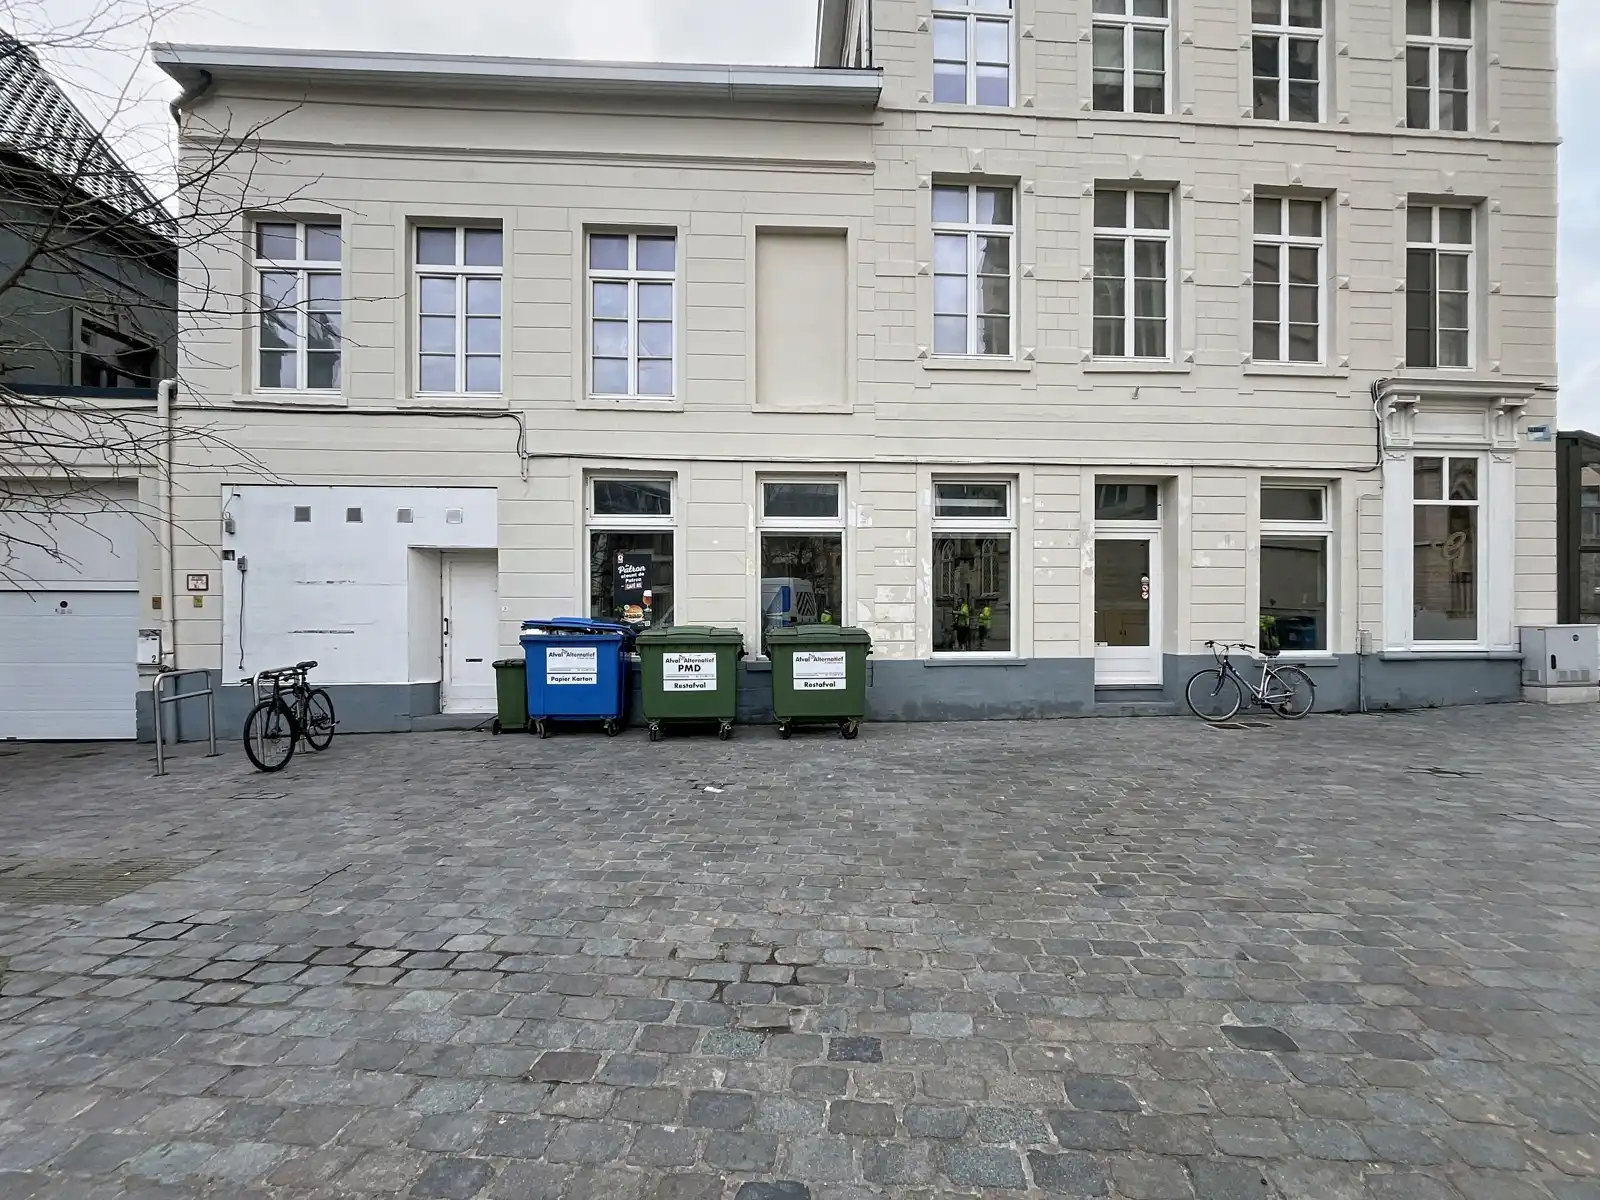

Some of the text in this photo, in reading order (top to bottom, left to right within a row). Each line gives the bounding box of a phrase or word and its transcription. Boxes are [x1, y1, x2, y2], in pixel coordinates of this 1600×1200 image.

[617, 565, 646, 574] Patron
[151, 654, 157, 664] 2
[678, 664, 702, 672] PMD
